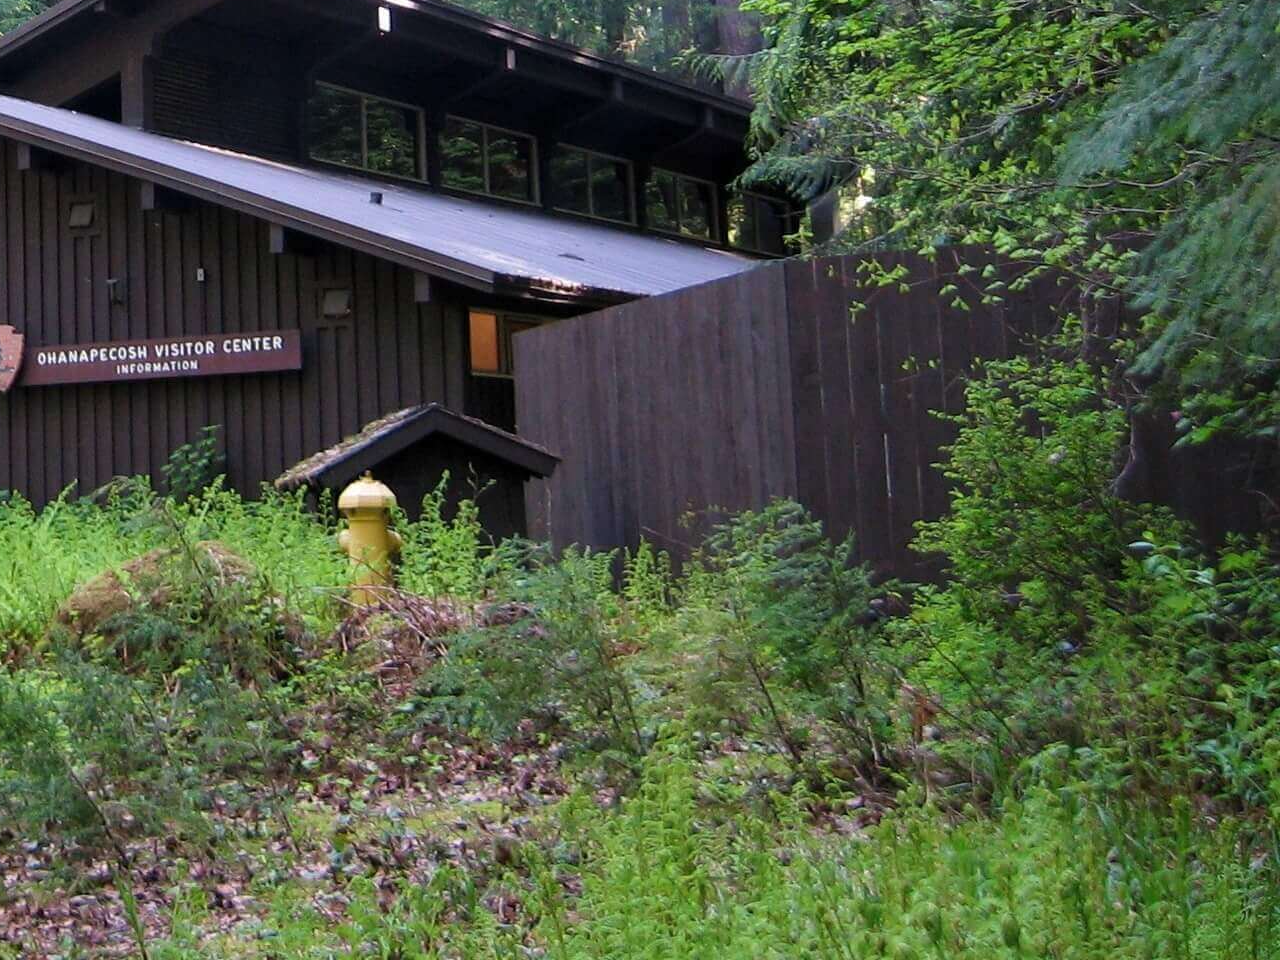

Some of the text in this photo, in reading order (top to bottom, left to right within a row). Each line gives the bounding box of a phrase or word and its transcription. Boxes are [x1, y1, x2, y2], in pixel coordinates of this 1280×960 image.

[37, 336, 282, 365] OHANAPECOSH VISITOR CENTER
[116, 359, 198, 374] INFORMATION
